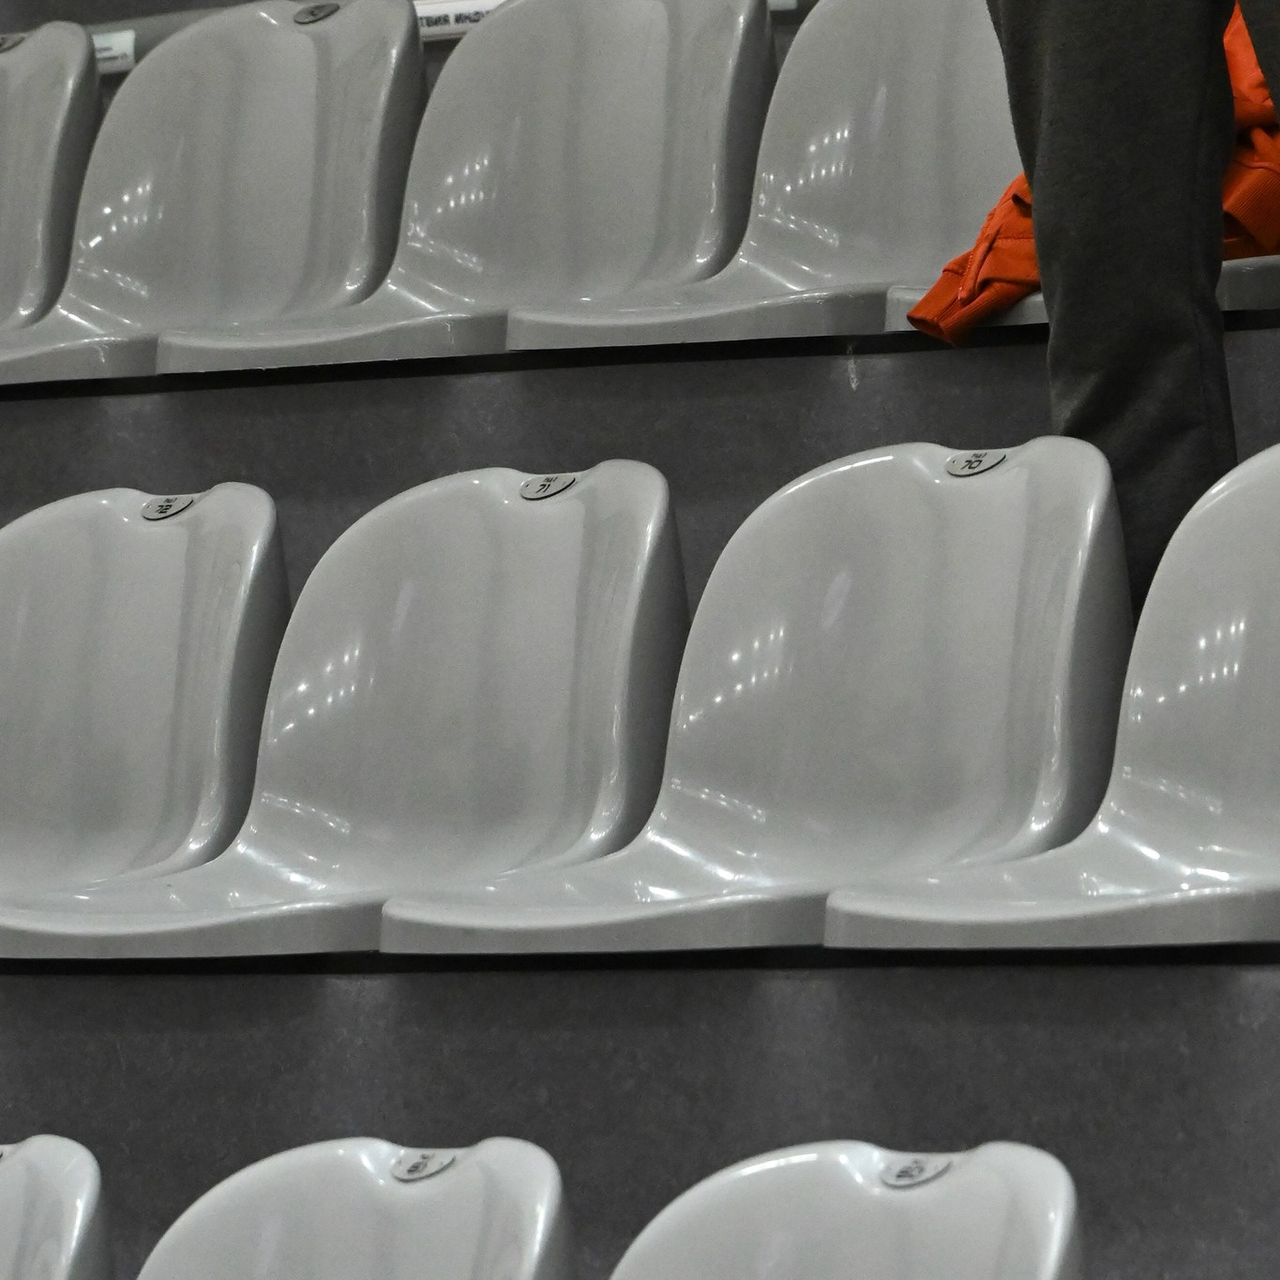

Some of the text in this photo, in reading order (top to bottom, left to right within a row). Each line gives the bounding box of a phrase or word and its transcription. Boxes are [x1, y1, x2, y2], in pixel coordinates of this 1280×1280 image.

[961, 459, 983, 470] 70
[535, 483, 551, 494] 71
[155, 504, 173, 514] 72
